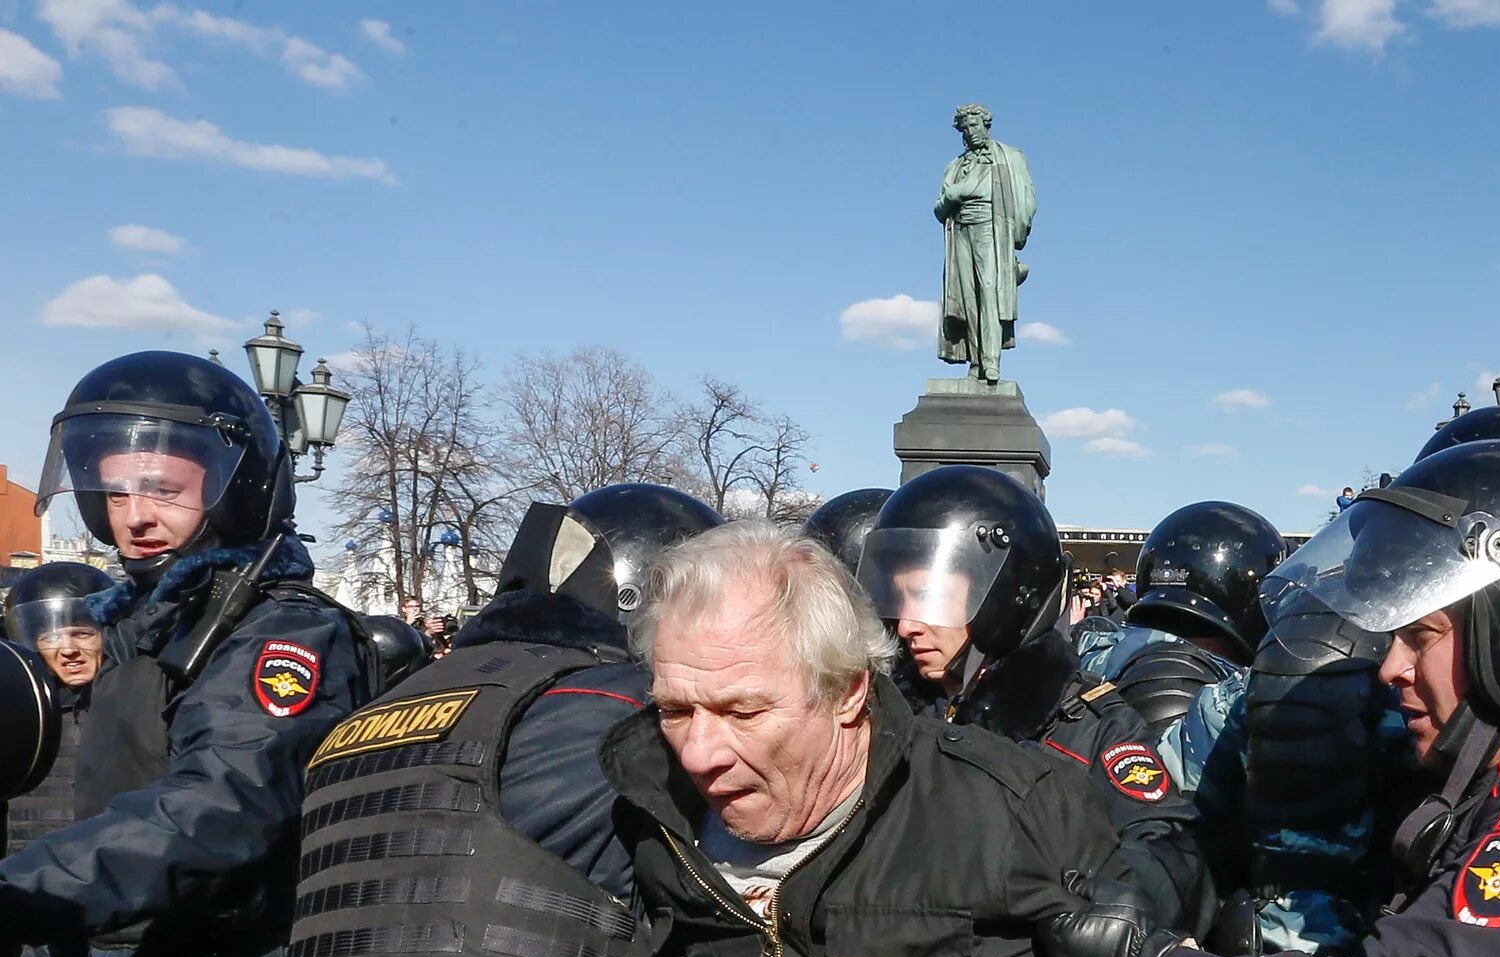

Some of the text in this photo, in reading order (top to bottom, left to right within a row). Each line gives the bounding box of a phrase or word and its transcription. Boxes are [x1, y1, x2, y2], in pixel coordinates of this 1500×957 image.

[1100, 533, 1144, 541] ПЕРВО
[268, 643, 316, 663] ПОЛИЦИЯ
[265, 659, 311, 680] РОССИЯ
[318, 699, 464, 756] ПОЛИЦИЯ
[1104, 745, 1146, 762] ПОЛИЦИЯ
[1113, 756, 1154, 775] РОССИЯ
